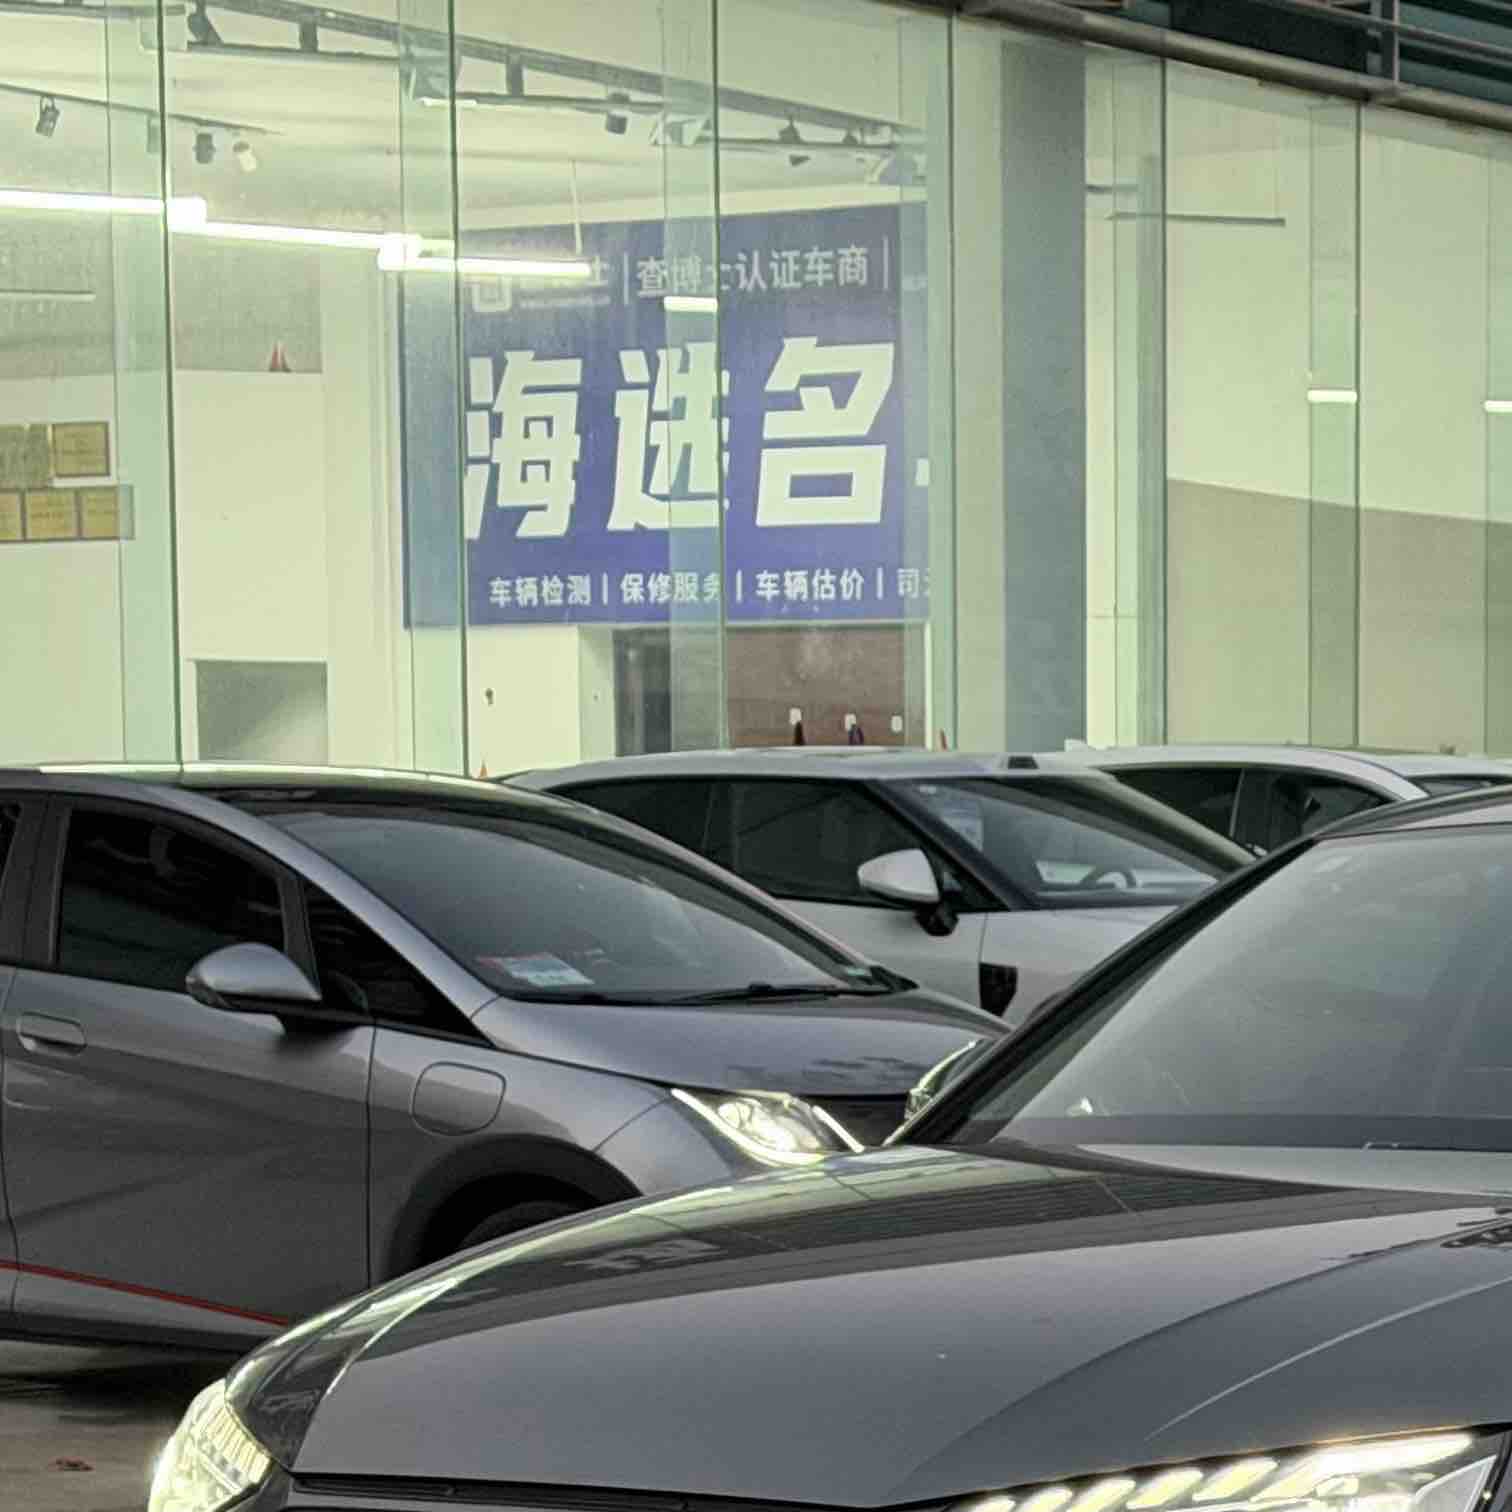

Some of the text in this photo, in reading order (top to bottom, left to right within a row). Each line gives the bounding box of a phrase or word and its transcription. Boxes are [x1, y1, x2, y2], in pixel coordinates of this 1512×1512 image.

[464, 336, 930, 540] 海选名
[488, 573, 592, 608] 车辆检测
[755, 567, 865, 602] 车辆估价
